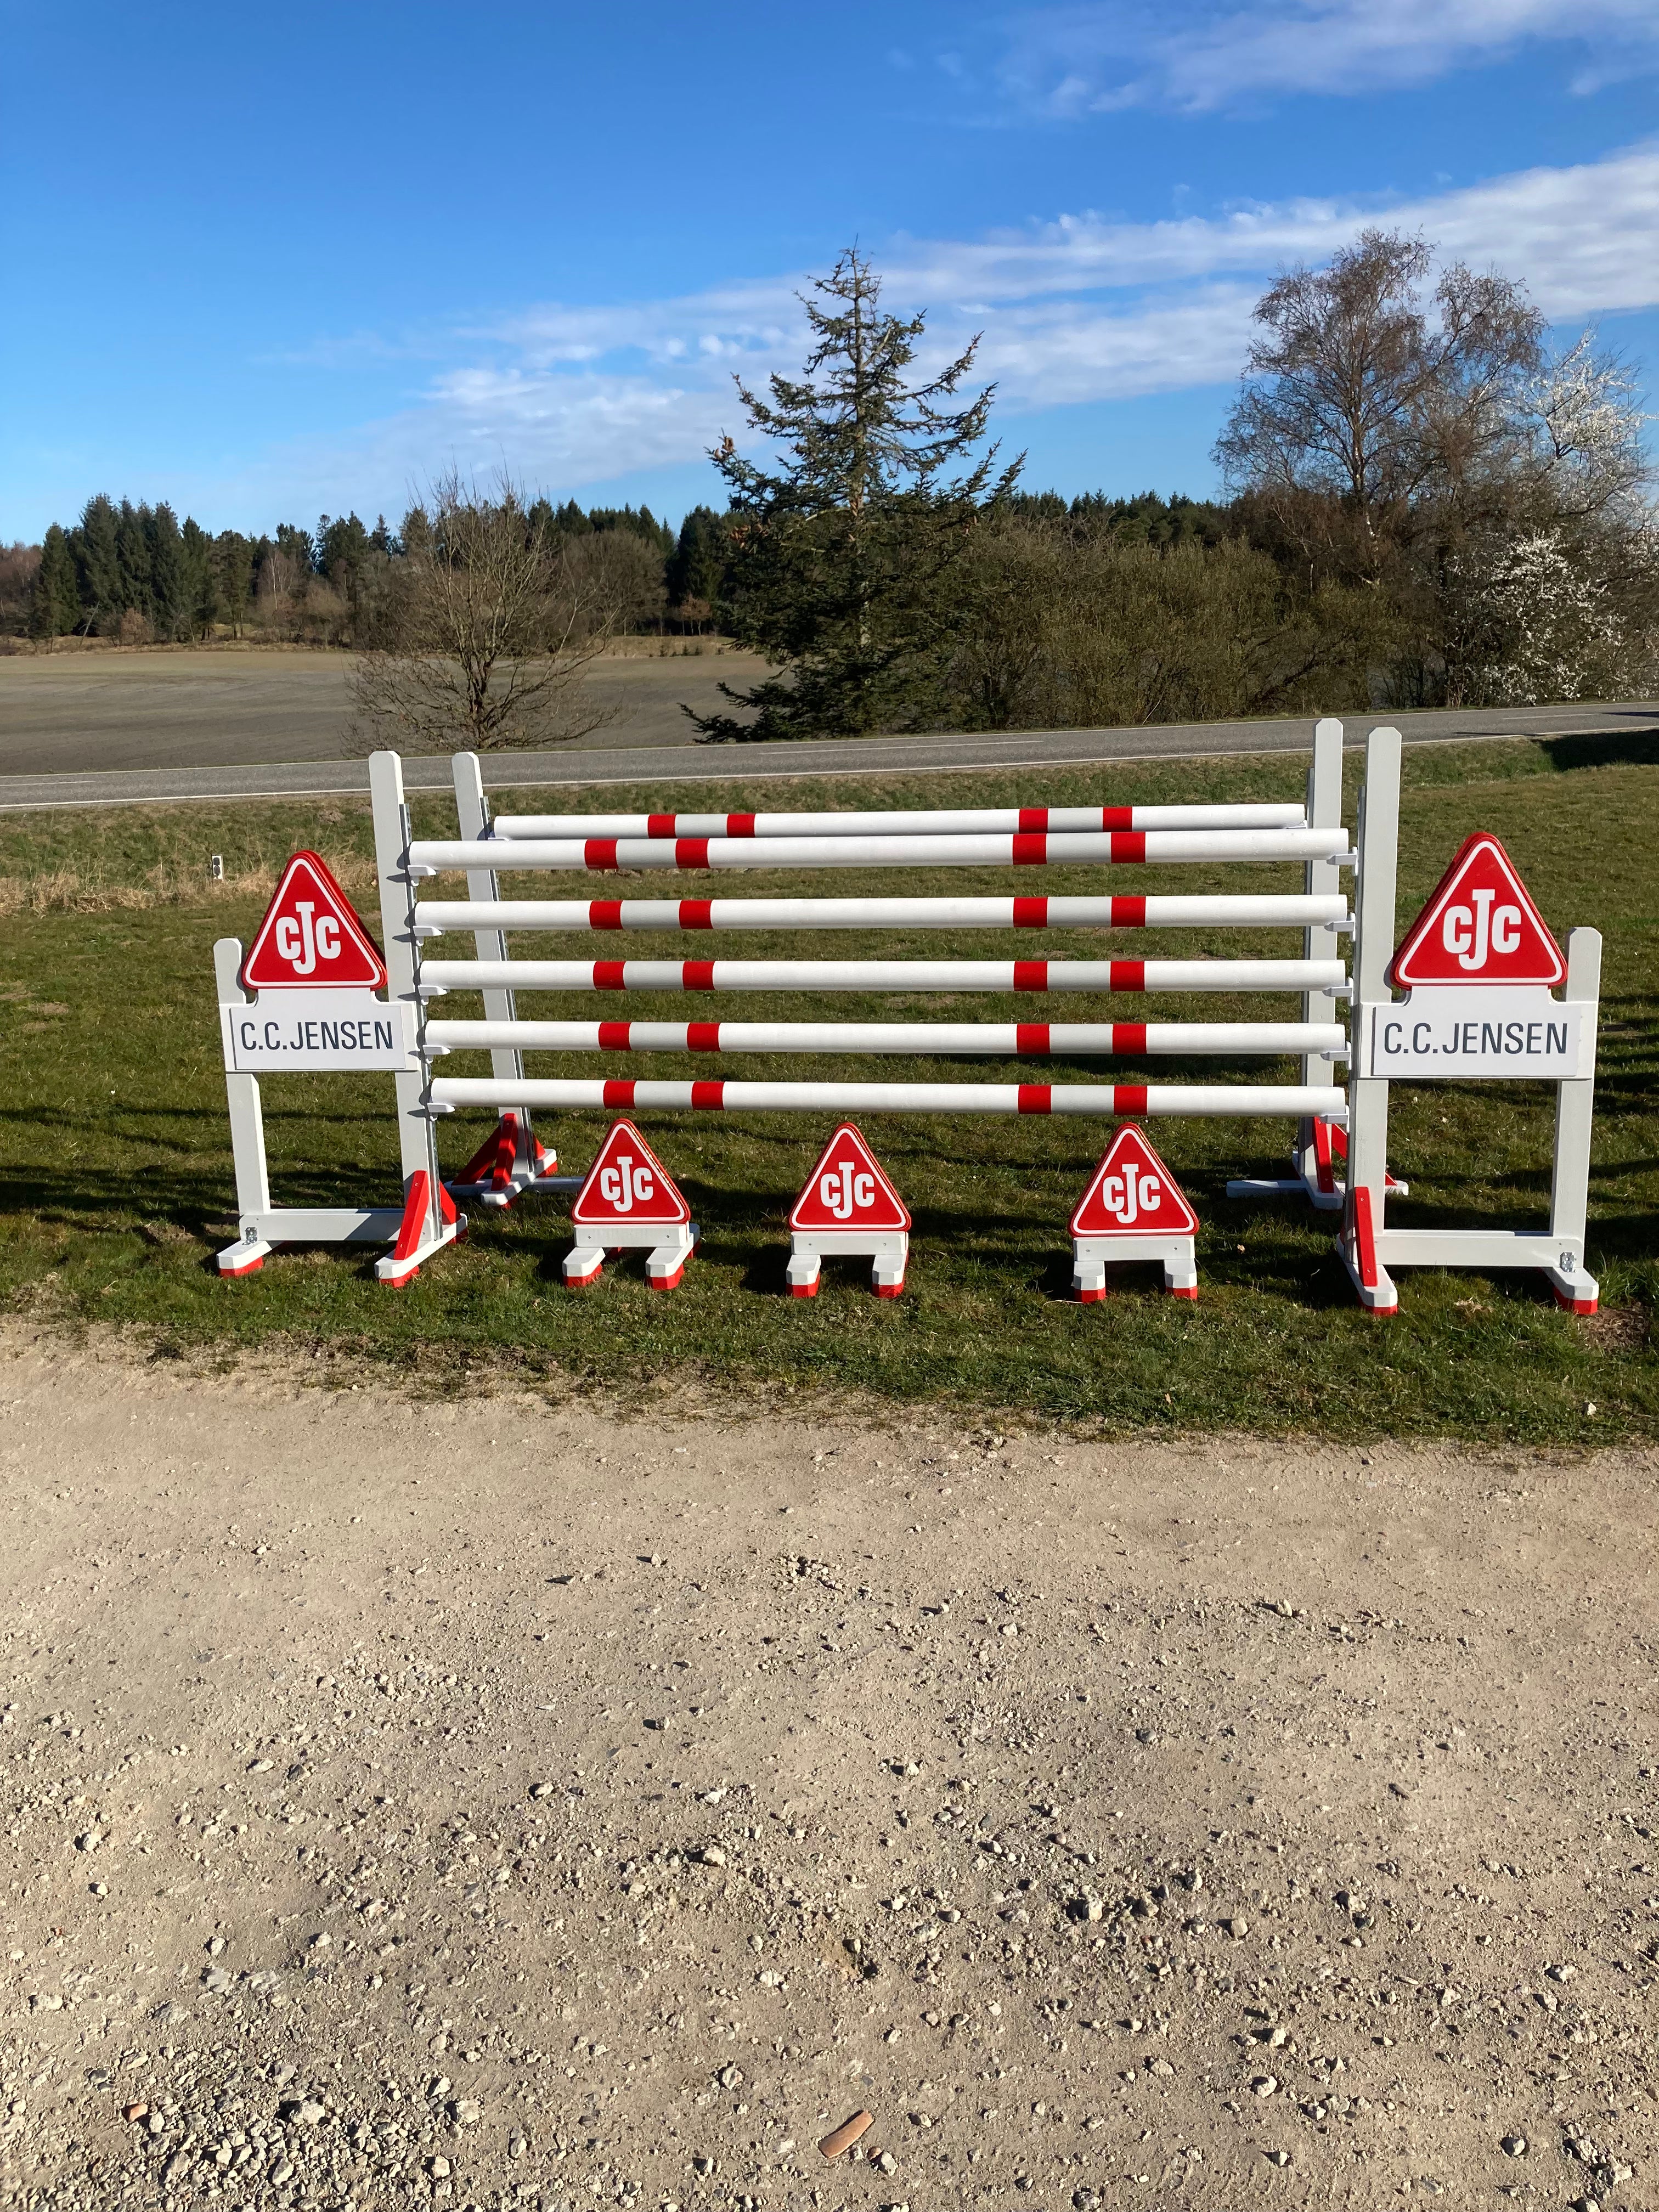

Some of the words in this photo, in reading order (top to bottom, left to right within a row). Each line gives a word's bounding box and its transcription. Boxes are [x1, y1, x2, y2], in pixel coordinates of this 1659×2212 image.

[275, 901, 341, 974] CJC
[1443, 889, 1521, 970] CJC
[600, 1156, 653, 1212] CJC
[820, 1161, 875, 1219] CJC
[1102, 1163, 1161, 1224] CJC
